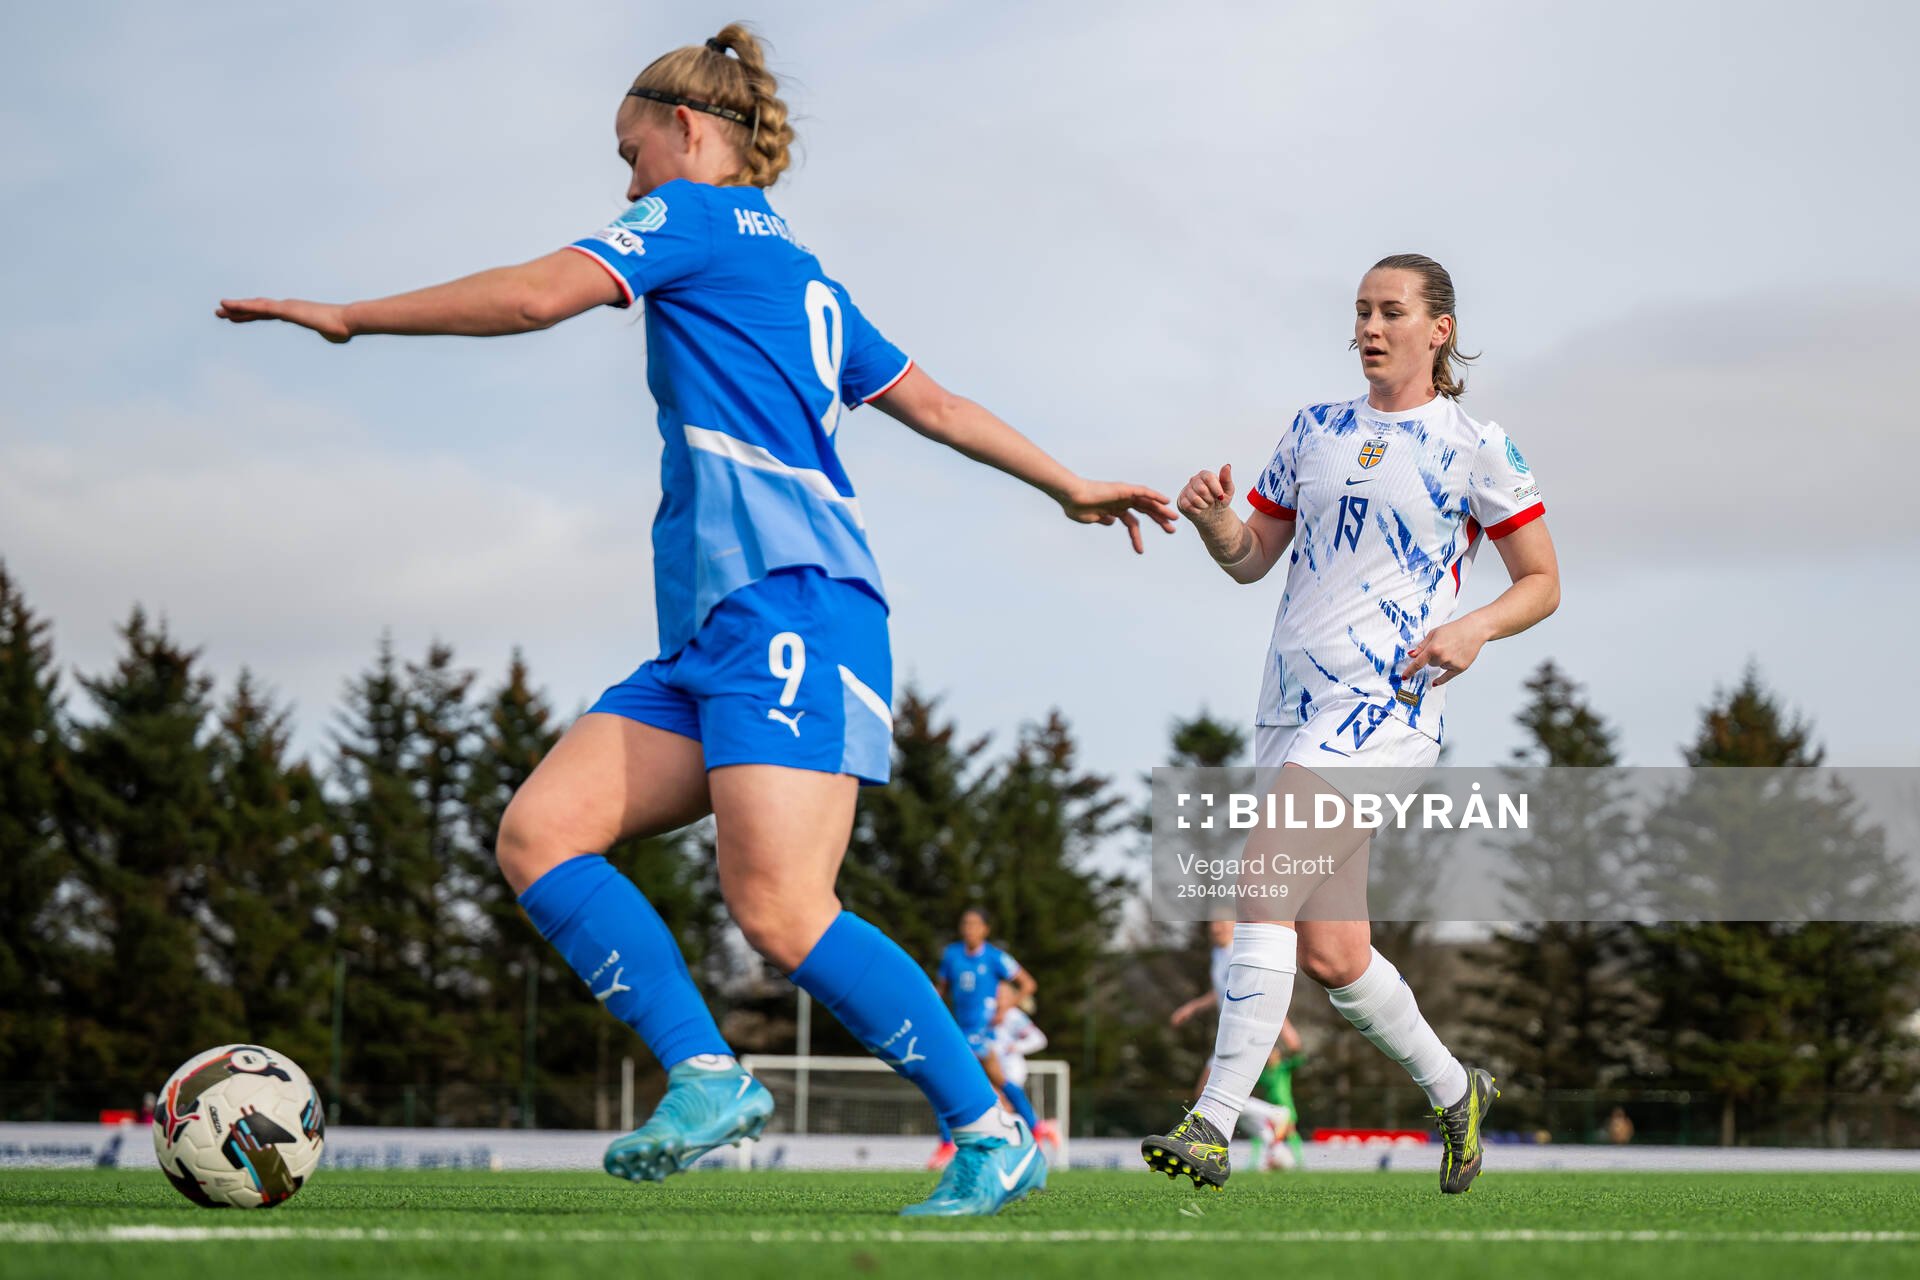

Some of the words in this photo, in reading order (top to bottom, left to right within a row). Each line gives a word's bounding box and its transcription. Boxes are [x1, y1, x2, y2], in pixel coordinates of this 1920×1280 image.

[804, 279, 844, 437] 9
[1333, 495, 1369, 554] 19
[768, 631, 806, 707] 9
[1336, 701, 1389, 750] 19
